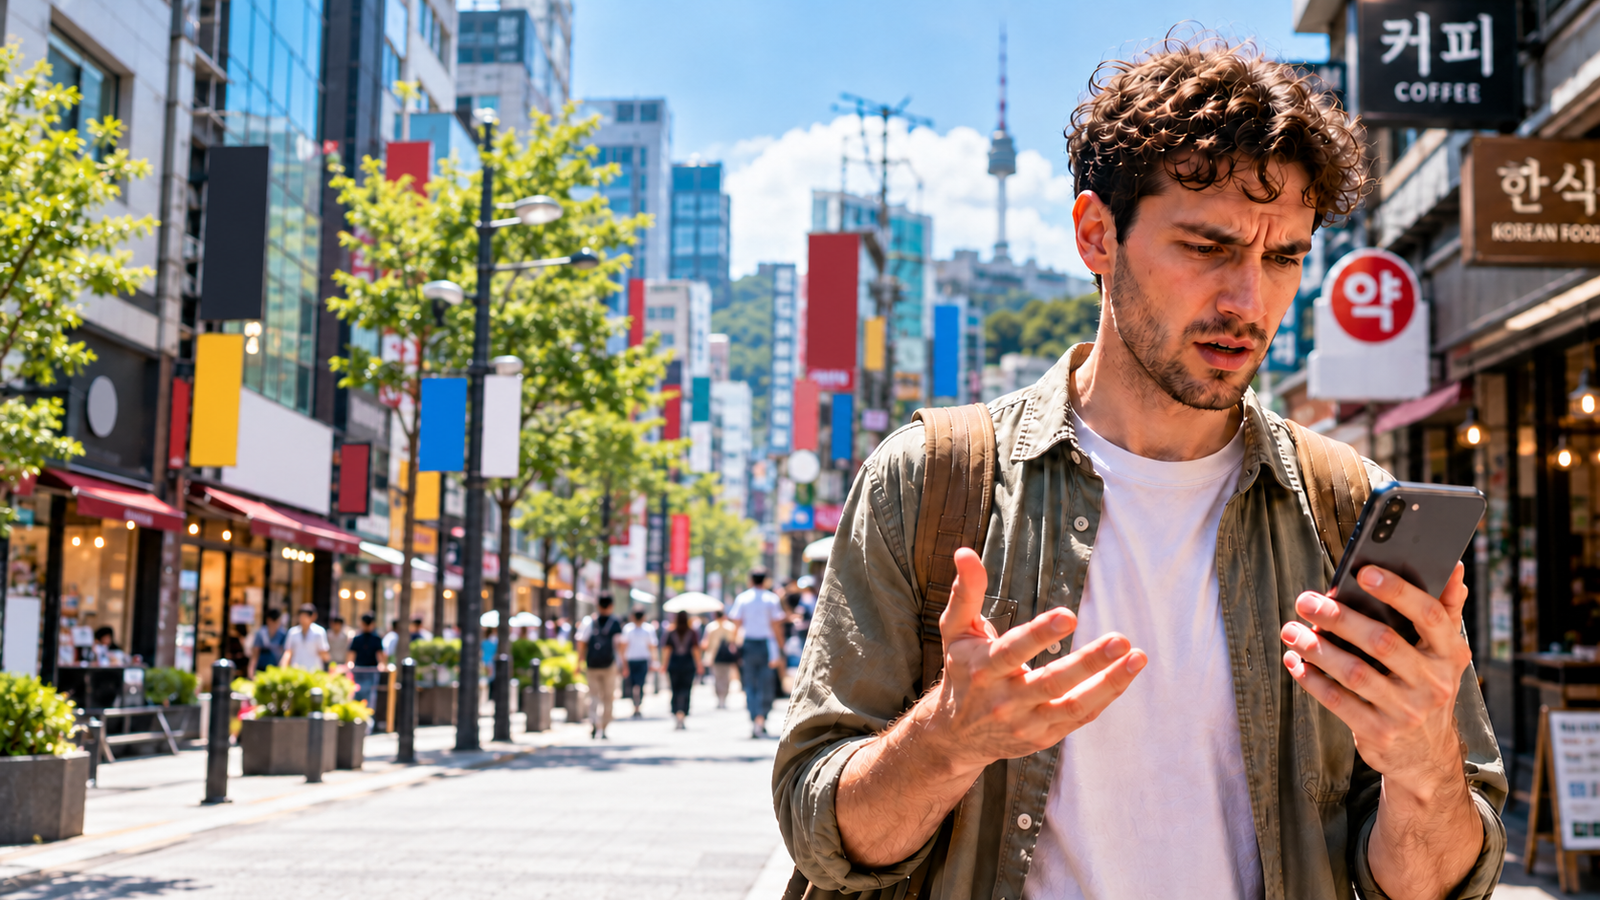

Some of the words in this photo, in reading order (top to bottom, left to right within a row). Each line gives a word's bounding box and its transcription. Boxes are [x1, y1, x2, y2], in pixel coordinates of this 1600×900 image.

[1380, 11, 1494, 78] 커피
[1394, 81, 1481, 104] COFFEE
[1496, 156, 1600, 217] 한식
[1491, 222, 1558, 242] KOREAN
[1343, 269, 1403, 333] 약
